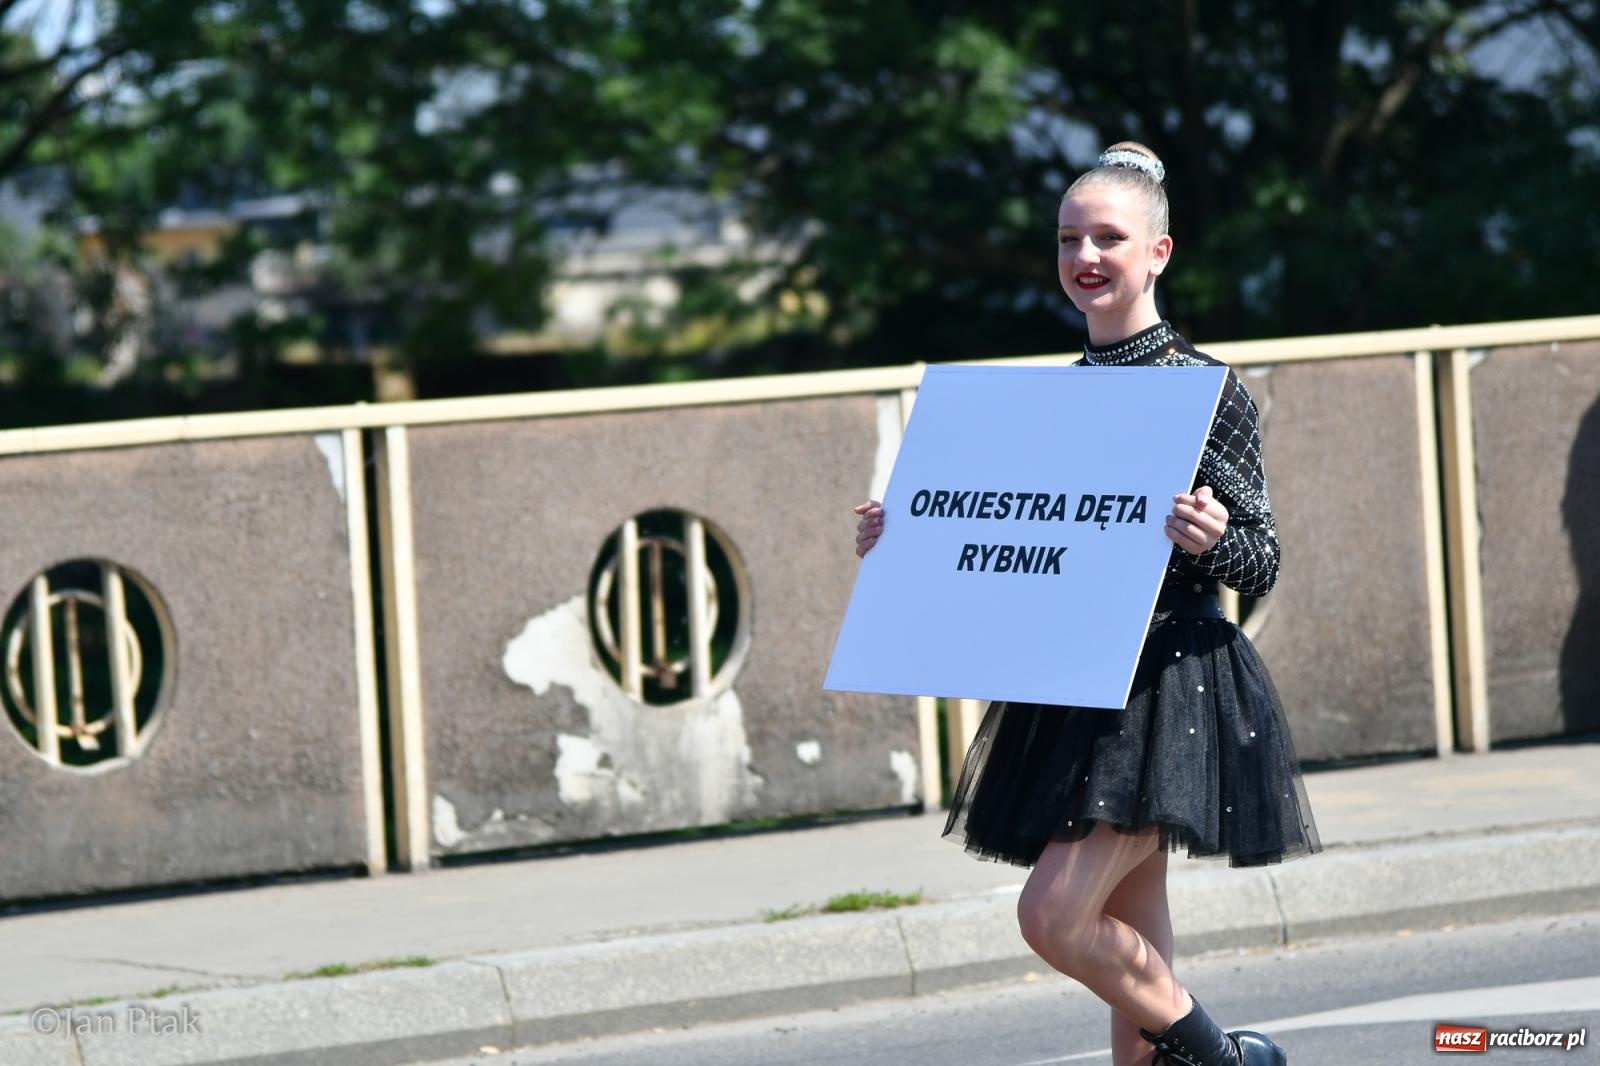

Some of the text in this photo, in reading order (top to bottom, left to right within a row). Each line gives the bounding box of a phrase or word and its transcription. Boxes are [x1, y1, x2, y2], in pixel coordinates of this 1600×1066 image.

[910, 489, 1147, 531] ORKIESTRA DĘTA
[956, 543, 1068, 575] RYBNIK
